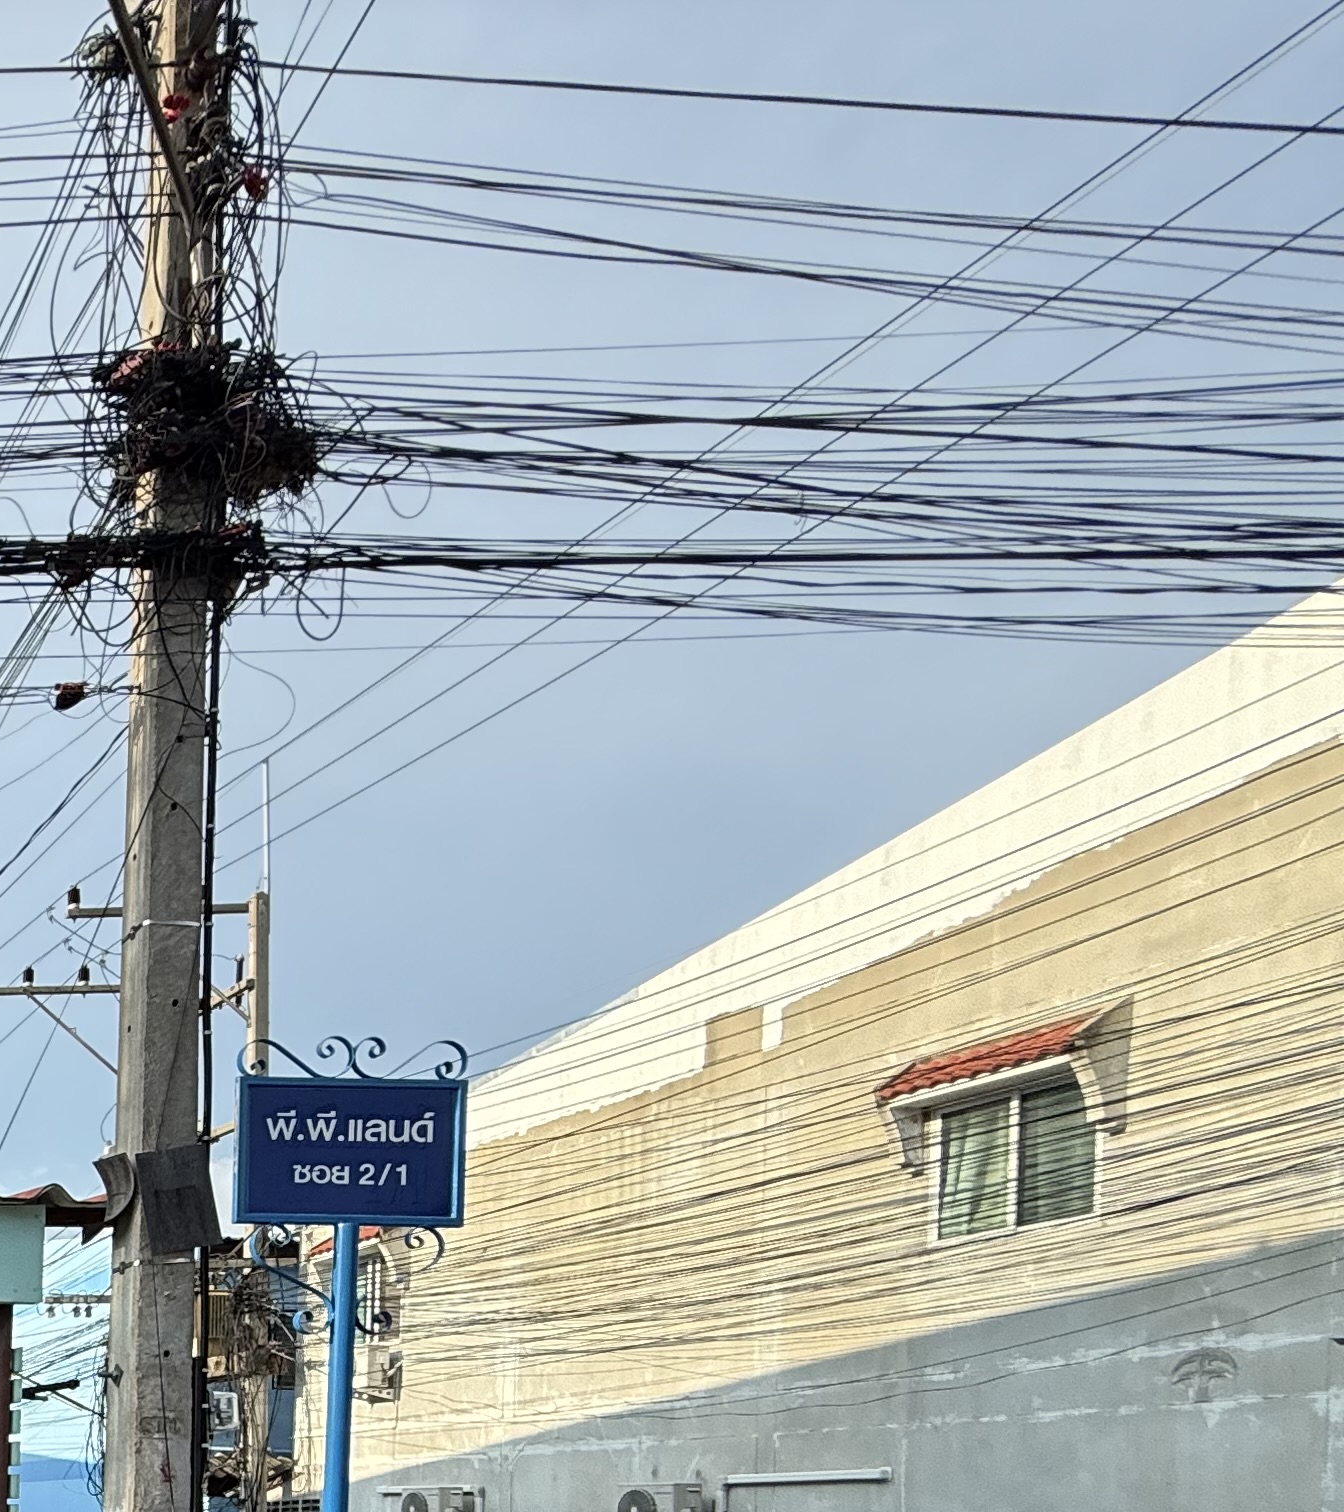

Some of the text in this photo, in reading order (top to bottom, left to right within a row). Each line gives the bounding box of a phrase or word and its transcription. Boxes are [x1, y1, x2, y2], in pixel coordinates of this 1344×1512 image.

[266, 1109, 435, 1143] พี.พี.แลนด์
[293, 1162, 408, 1186] ซอย 2/1
